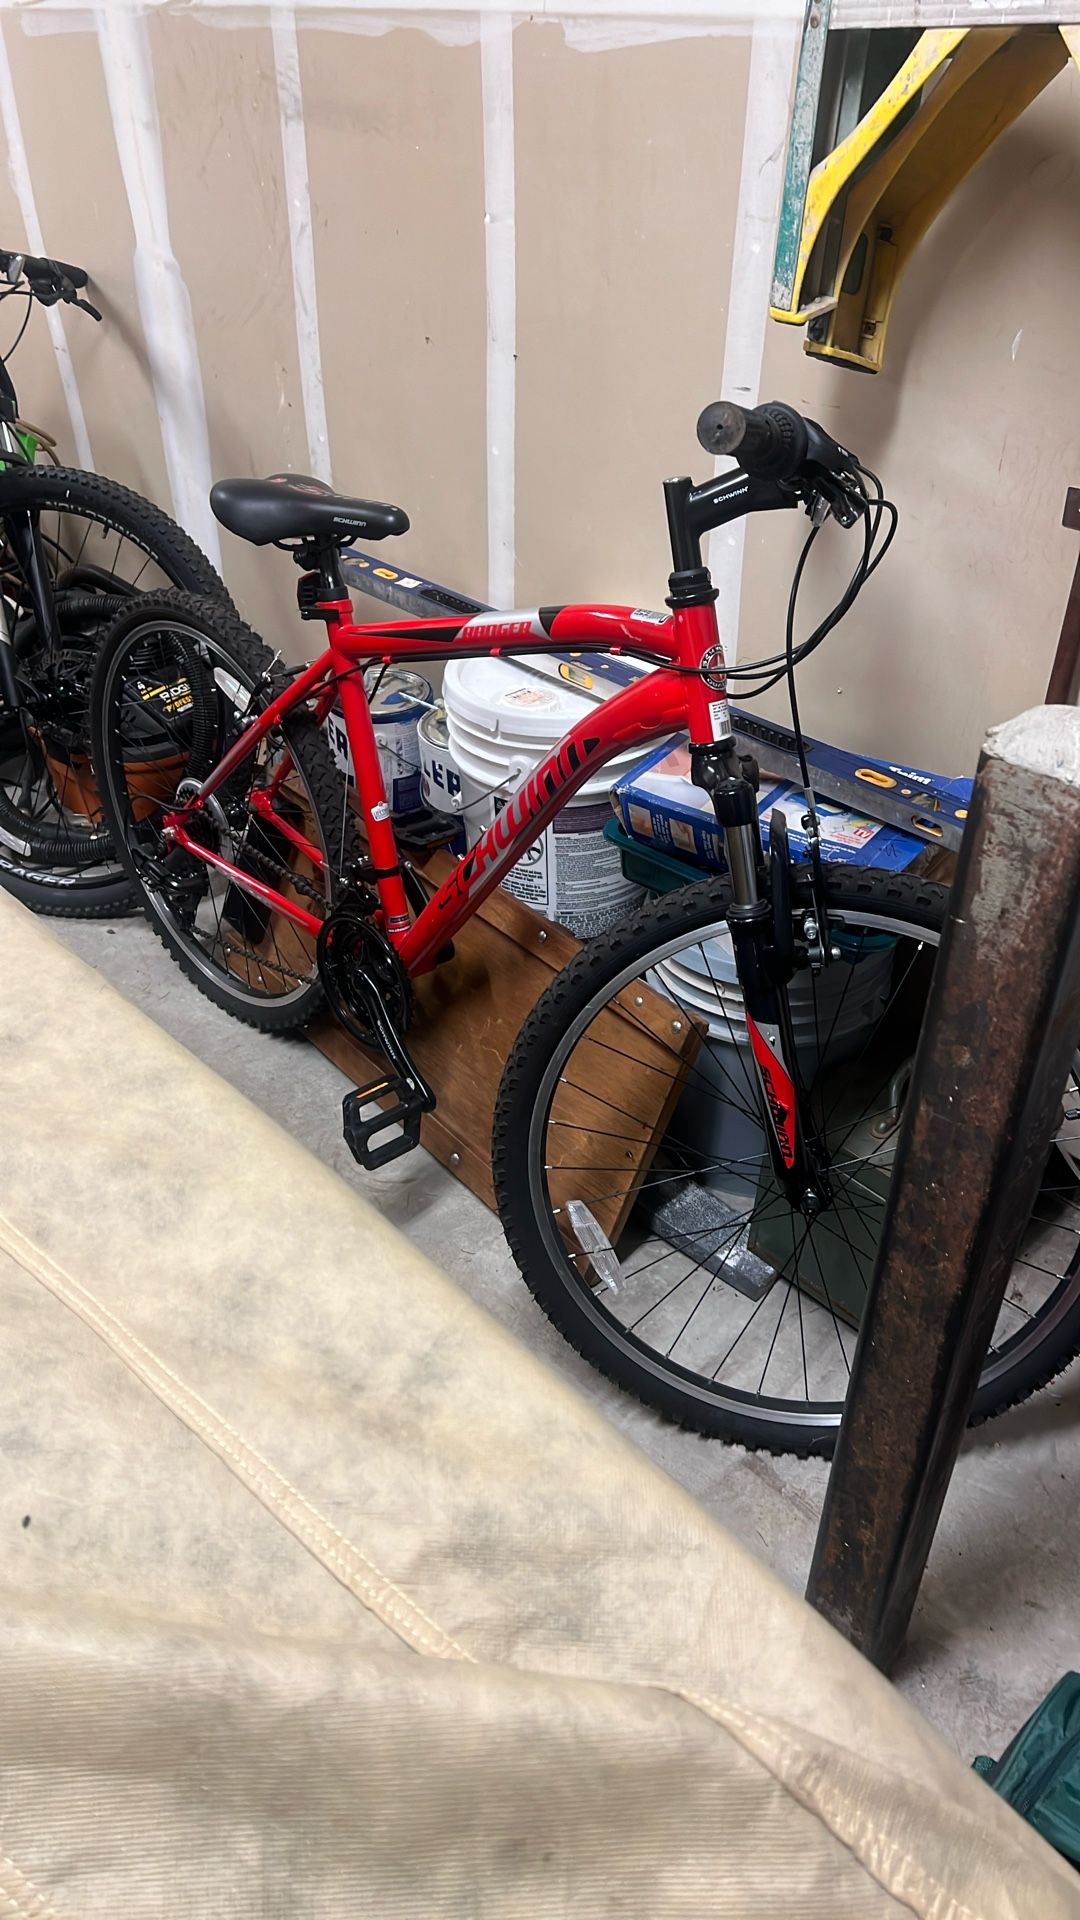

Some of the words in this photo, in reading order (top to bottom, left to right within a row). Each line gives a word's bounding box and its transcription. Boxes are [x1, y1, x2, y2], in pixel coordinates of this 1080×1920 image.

[713, 486, 748, 504] SCHWINN
[333, 516, 367, 527] SCHWINN
[462, 621, 532, 640] RANGER
[437, 737, 590, 910] SCHWINN
